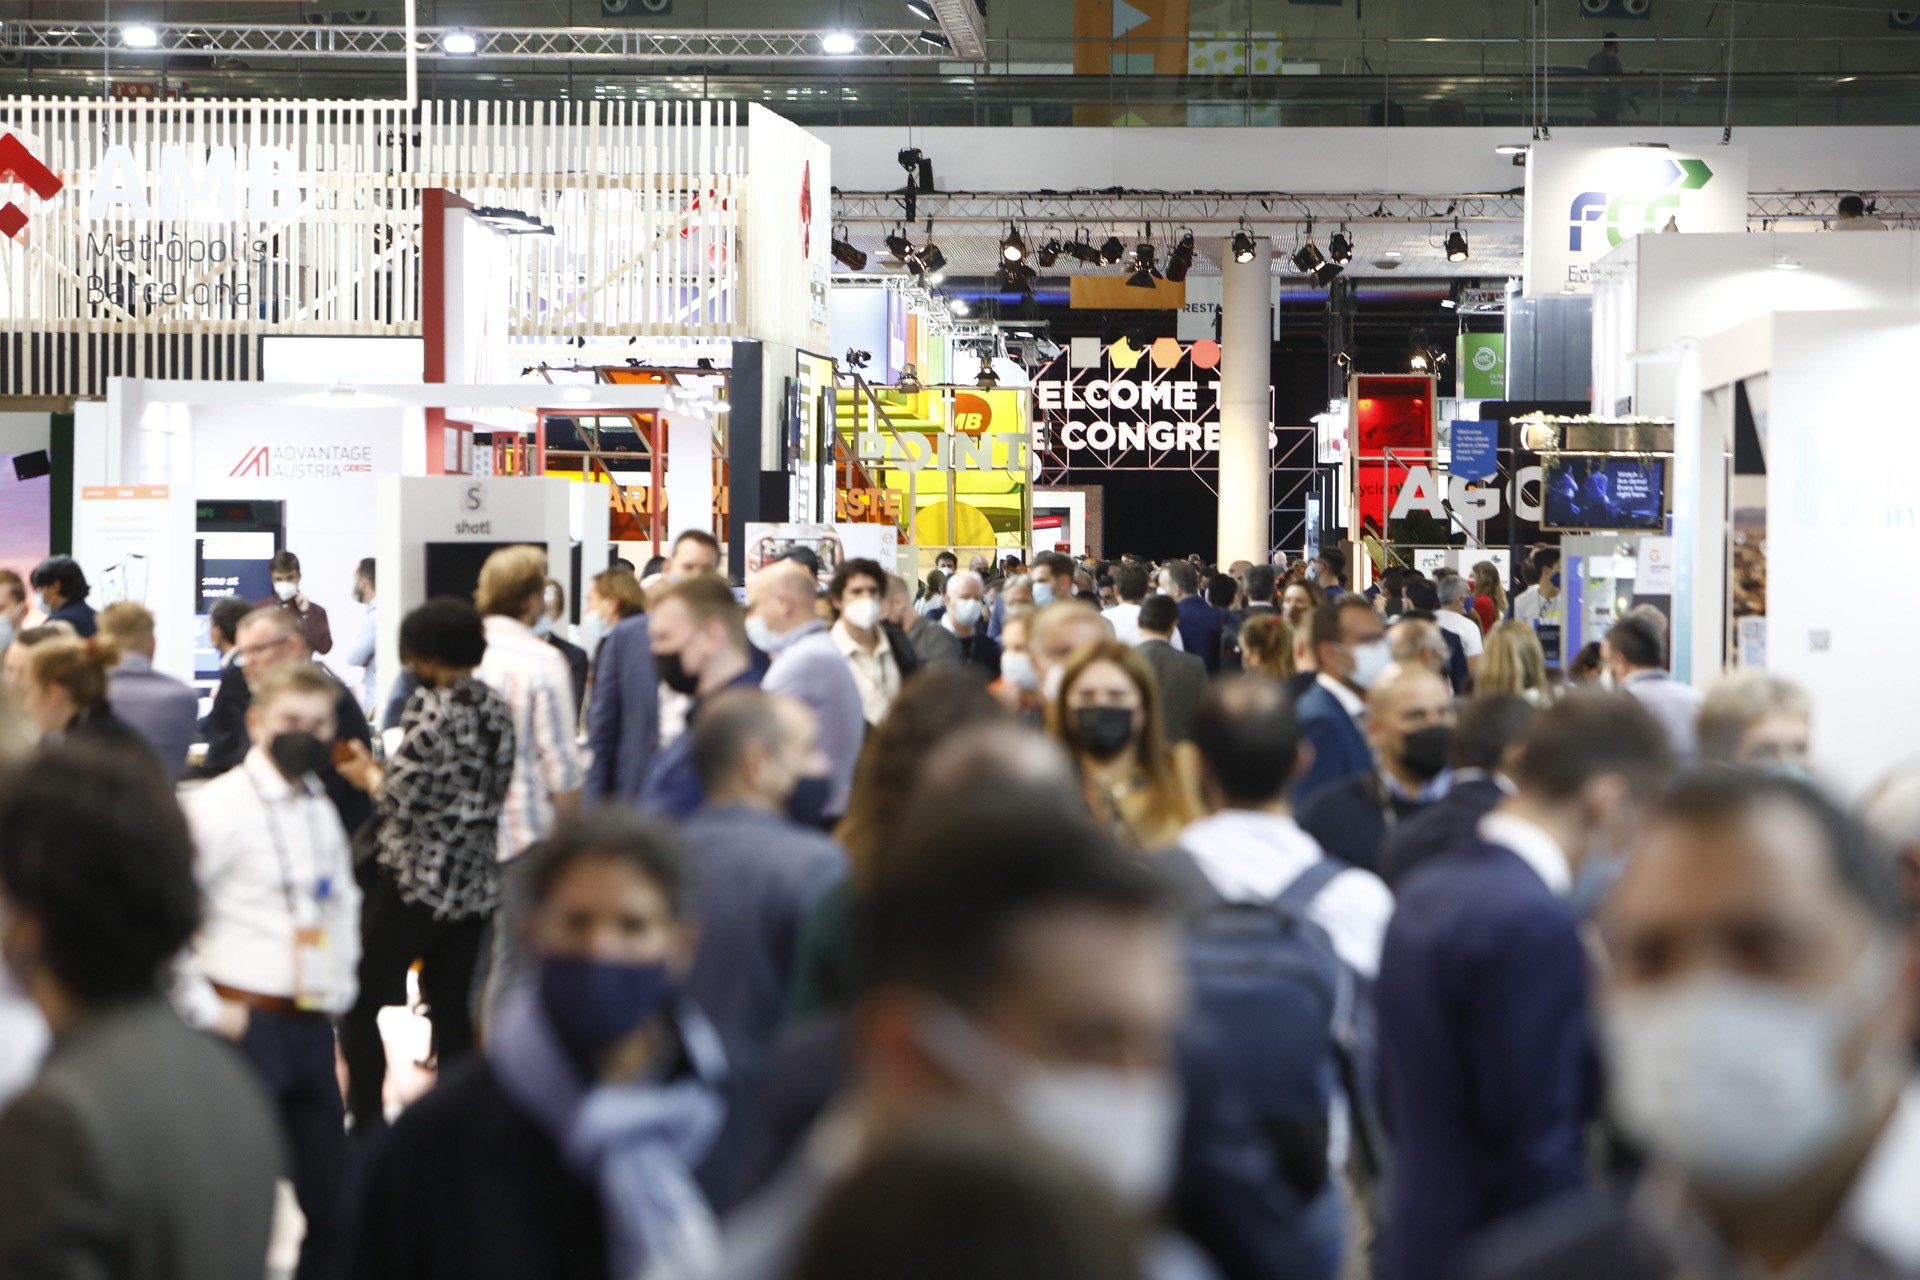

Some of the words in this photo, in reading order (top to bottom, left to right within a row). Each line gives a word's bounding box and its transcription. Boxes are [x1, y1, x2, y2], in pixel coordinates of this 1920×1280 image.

[89, 145, 302, 220] AMB
[87, 275, 252, 306] Barcelona
[1032, 379, 1198, 410] ELCOME
[1060, 420, 1278, 451] CONGRE
[274, 446, 372, 461] ADVANTAGE
[857, 431, 1032, 473] POINT
[274, 464, 341, 478] AUSTRIA
